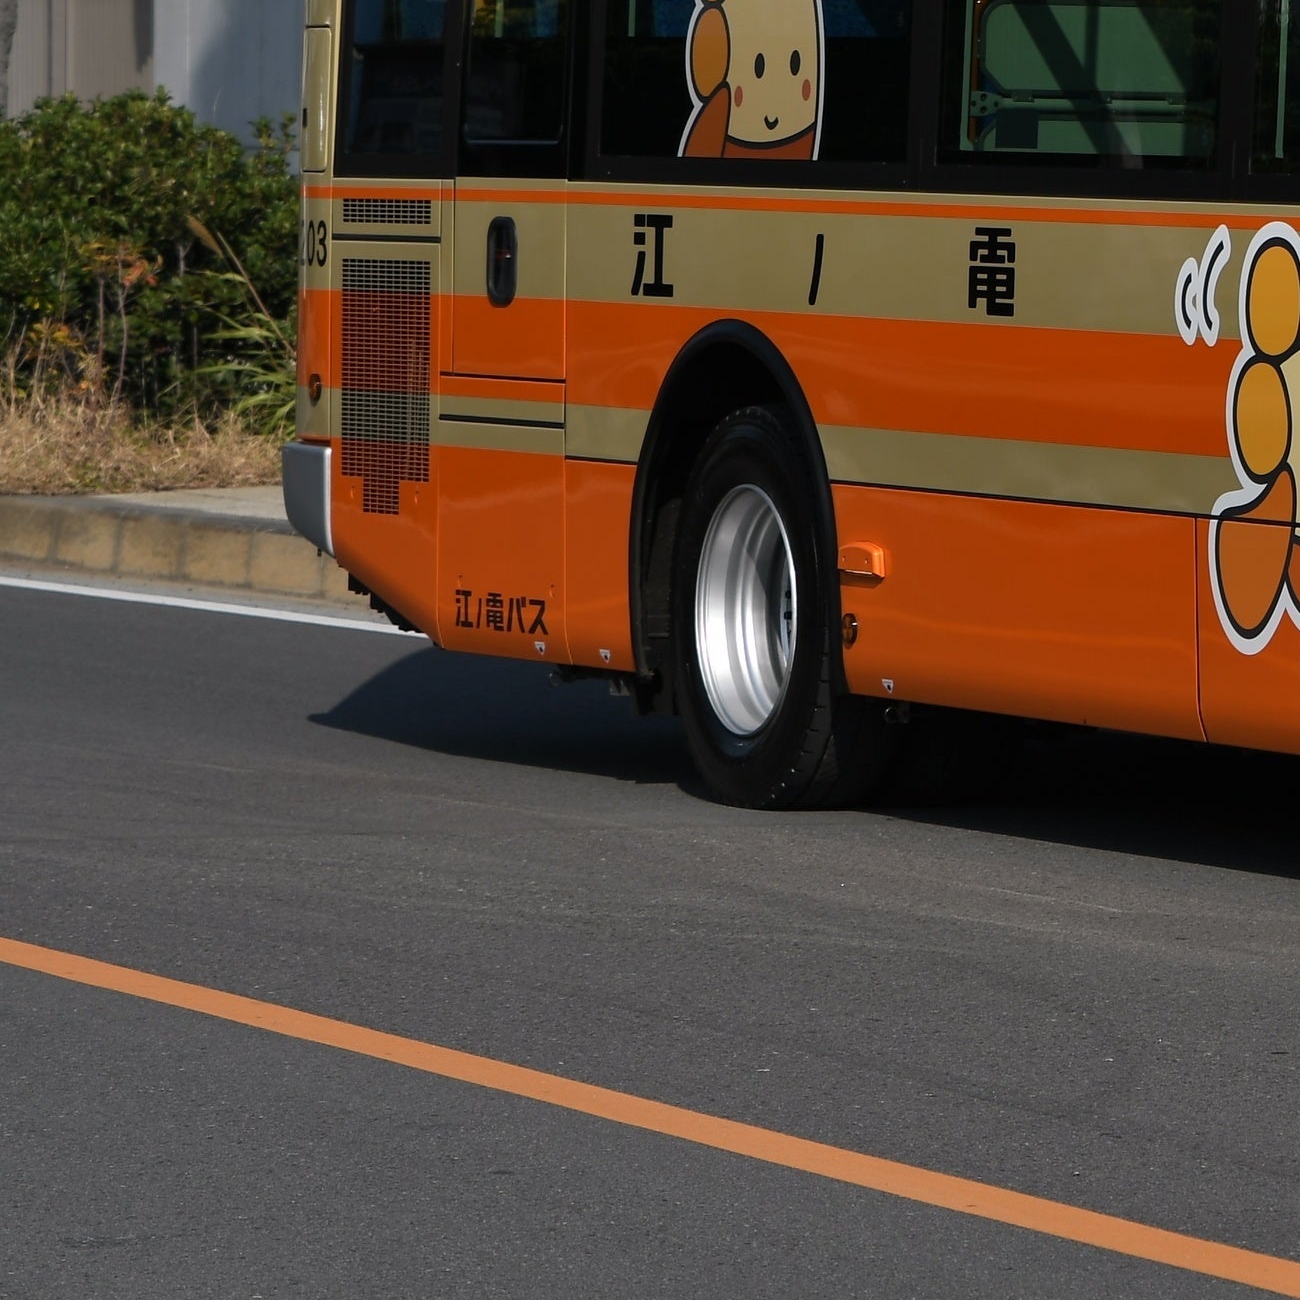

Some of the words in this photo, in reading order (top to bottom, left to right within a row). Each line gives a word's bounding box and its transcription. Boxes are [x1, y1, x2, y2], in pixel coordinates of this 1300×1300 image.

[631, 213, 1016, 317] 江ノ電
[455, 589, 549, 636] 江ノ電バス
